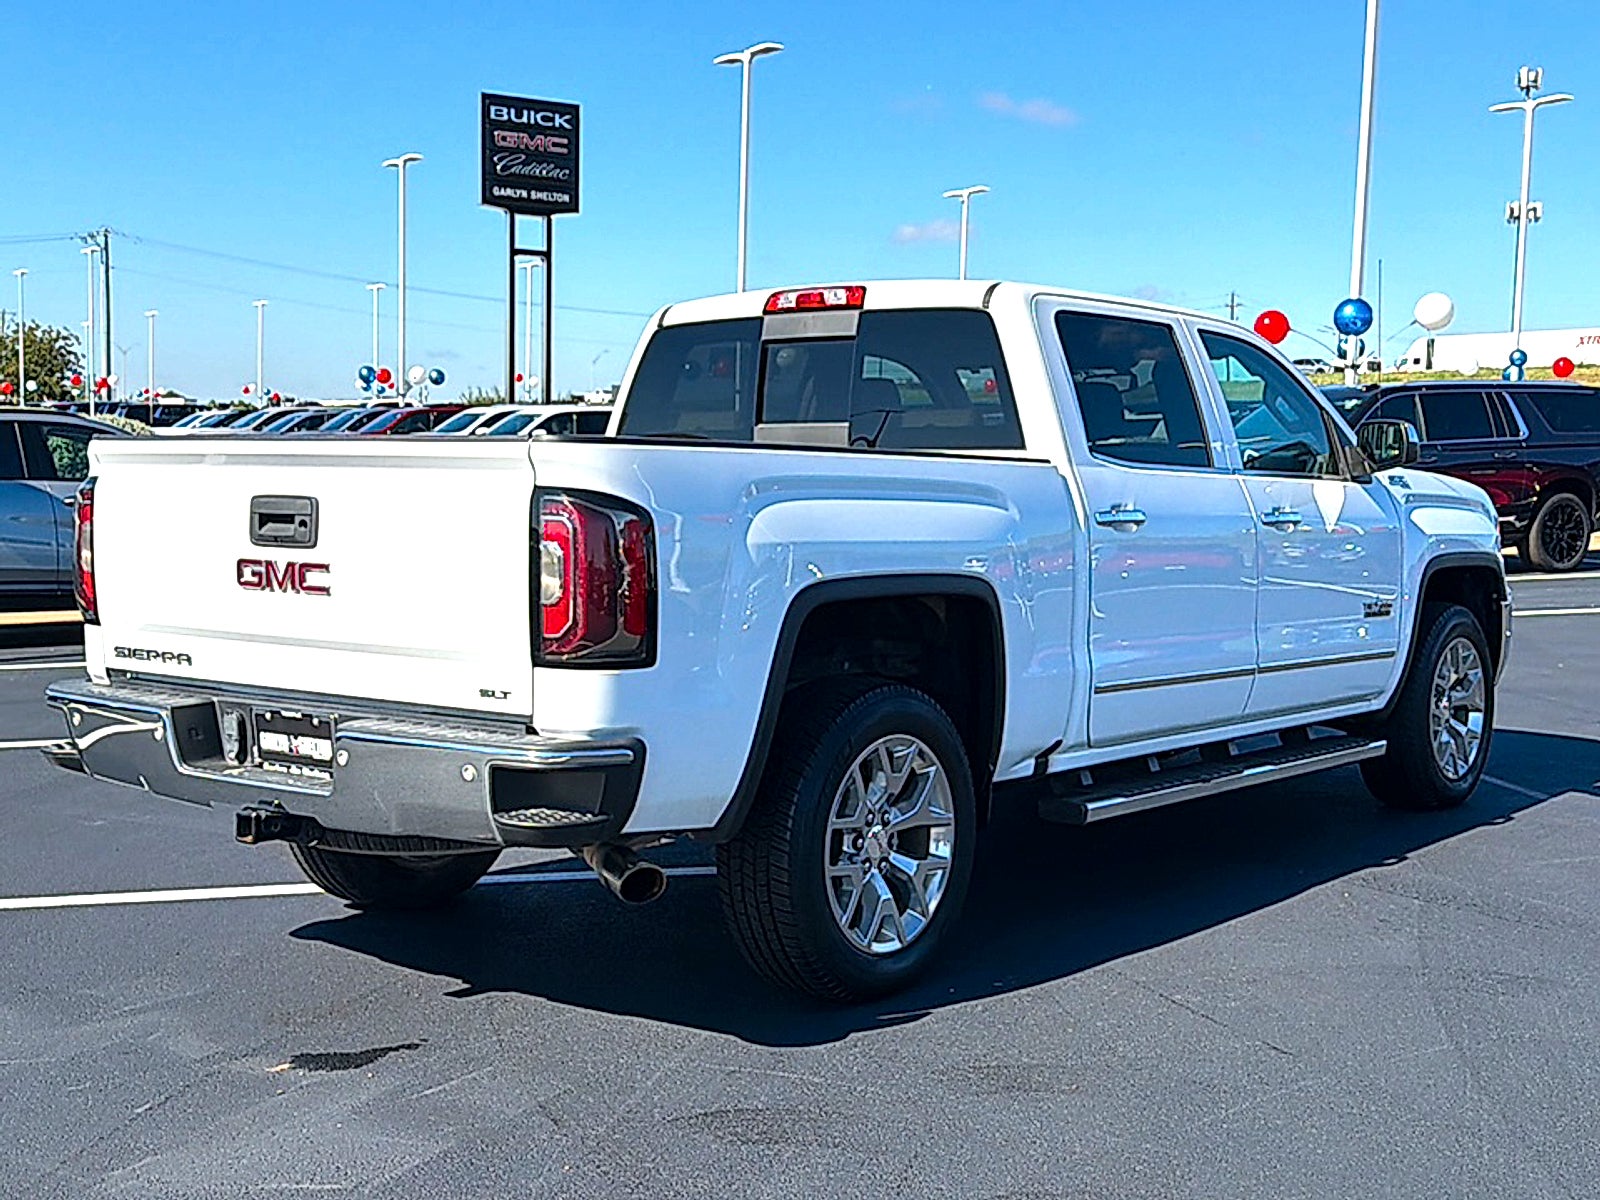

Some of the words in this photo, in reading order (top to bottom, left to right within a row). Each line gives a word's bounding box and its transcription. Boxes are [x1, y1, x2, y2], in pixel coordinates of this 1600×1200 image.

[490, 105, 573, 129] BUICK
[494, 130, 568, 154] GMC
[493, 152, 570, 180] Cadillac
[530, 189, 570, 203] SHELTON
[237, 558, 331, 596] GMC
[114, 645, 193, 667] SIERRA
